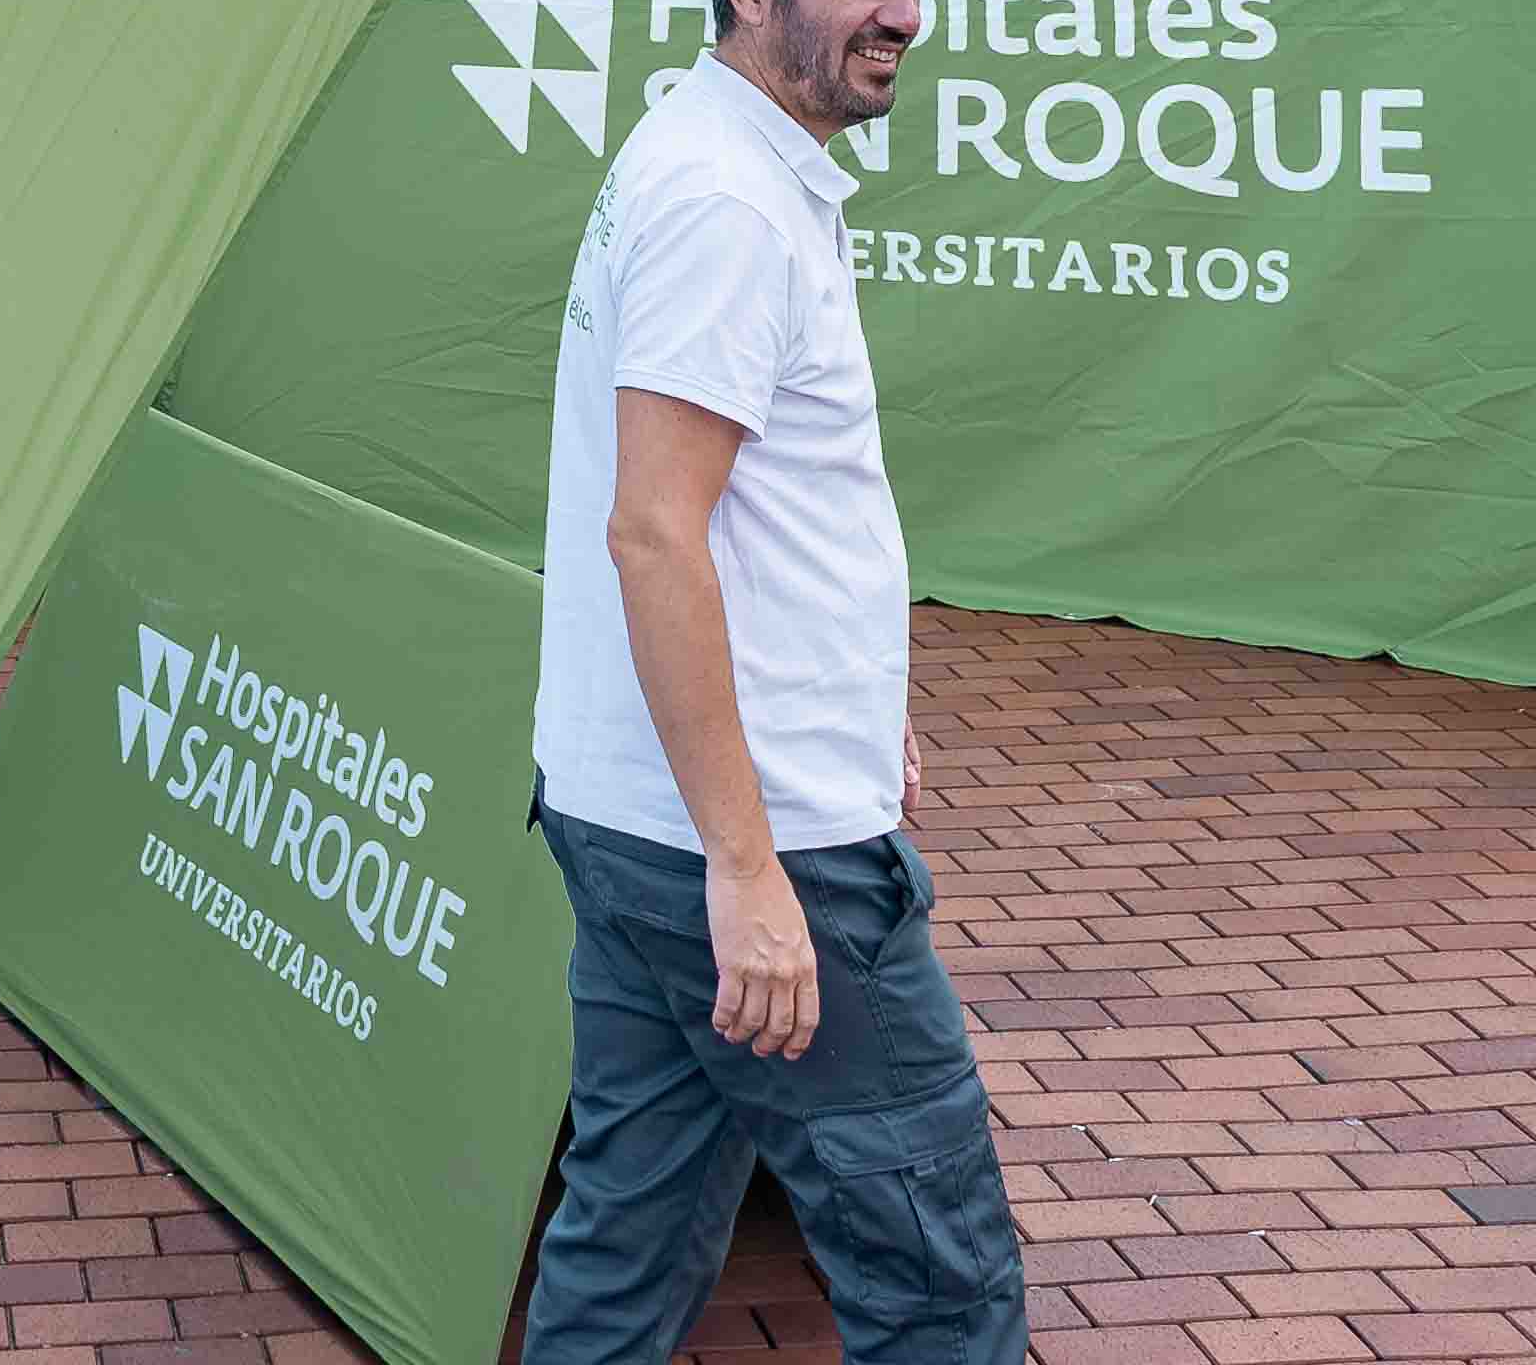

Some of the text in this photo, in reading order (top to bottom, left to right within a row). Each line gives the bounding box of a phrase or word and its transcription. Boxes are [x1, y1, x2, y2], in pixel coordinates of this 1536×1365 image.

[937, 77, 1431, 200] ROQUE
[850, 228, 1291, 305] ERSITARIOS
[196, 633, 433, 838] Hospitales
[139, 833, 378, 1042] UNIVERSITARIOS
[166, 725, 467, 988] SAN ROQUE
